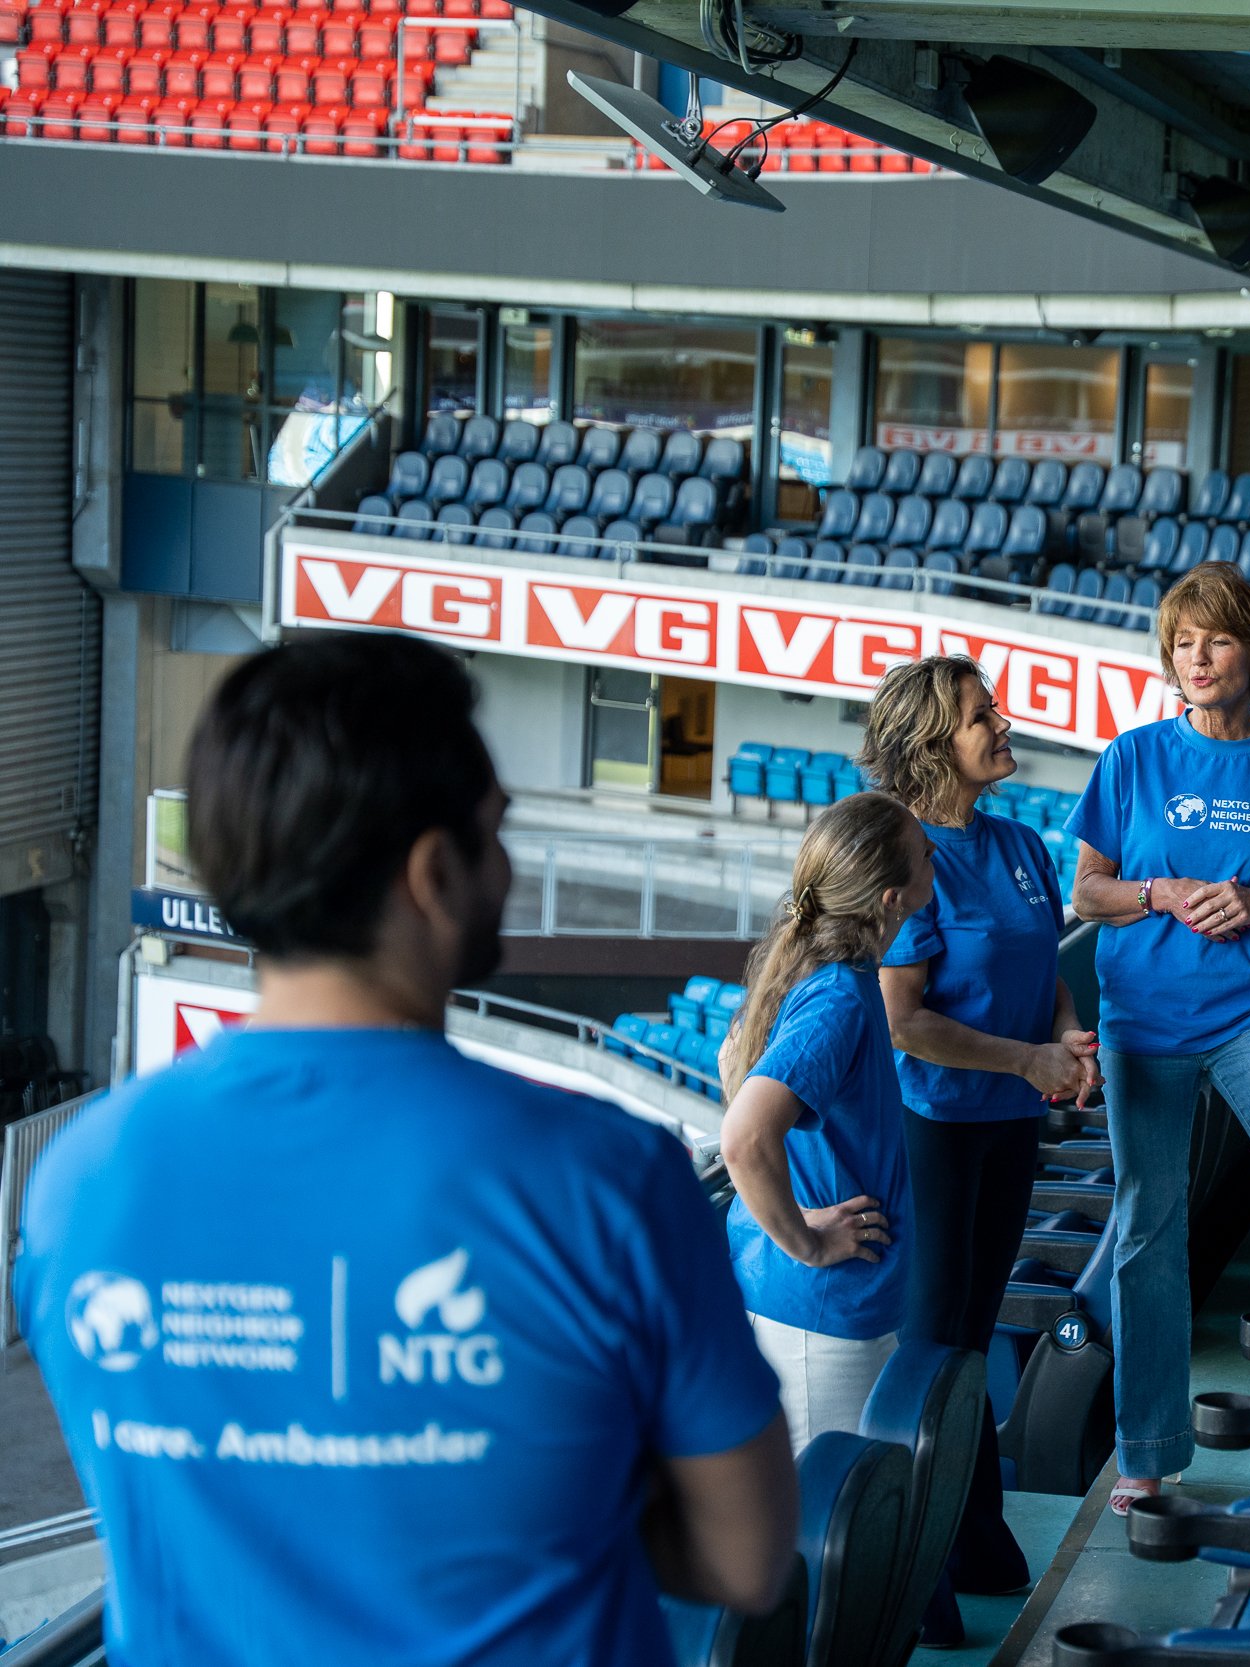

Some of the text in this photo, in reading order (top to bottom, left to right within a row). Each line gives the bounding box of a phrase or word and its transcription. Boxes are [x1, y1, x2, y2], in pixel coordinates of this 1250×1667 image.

[300, 559, 493, 638] VG
[532, 584, 712, 665] VG
[741, 608, 917, 686] VG
[1097, 664, 1190, 736] V
[162, 897, 235, 936] ULLE
[1060, 1323, 1078, 1340] 41
[378, 1333, 504, 1386] NTG
